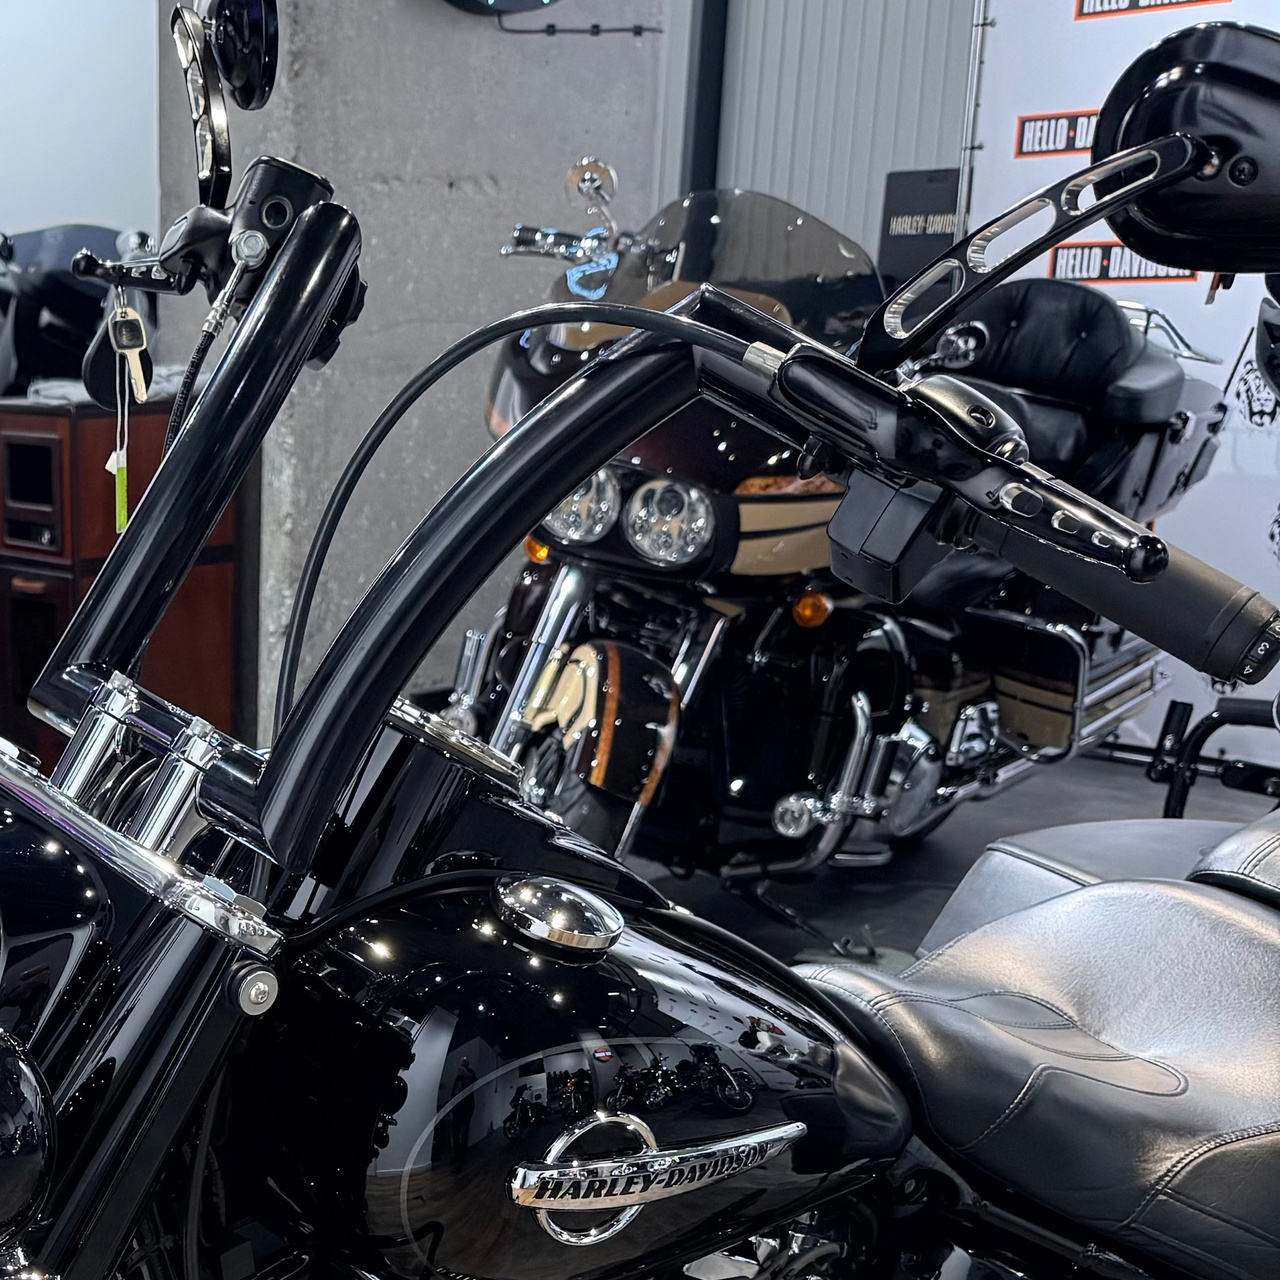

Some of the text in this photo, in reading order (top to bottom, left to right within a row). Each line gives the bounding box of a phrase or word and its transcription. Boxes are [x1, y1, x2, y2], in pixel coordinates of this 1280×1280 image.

[1022, 117, 1069, 153] HELLO
[1054, 246, 1103, 279] HELLO
[532, 1142, 770, 1201] HARLEY-DAVIDSON
